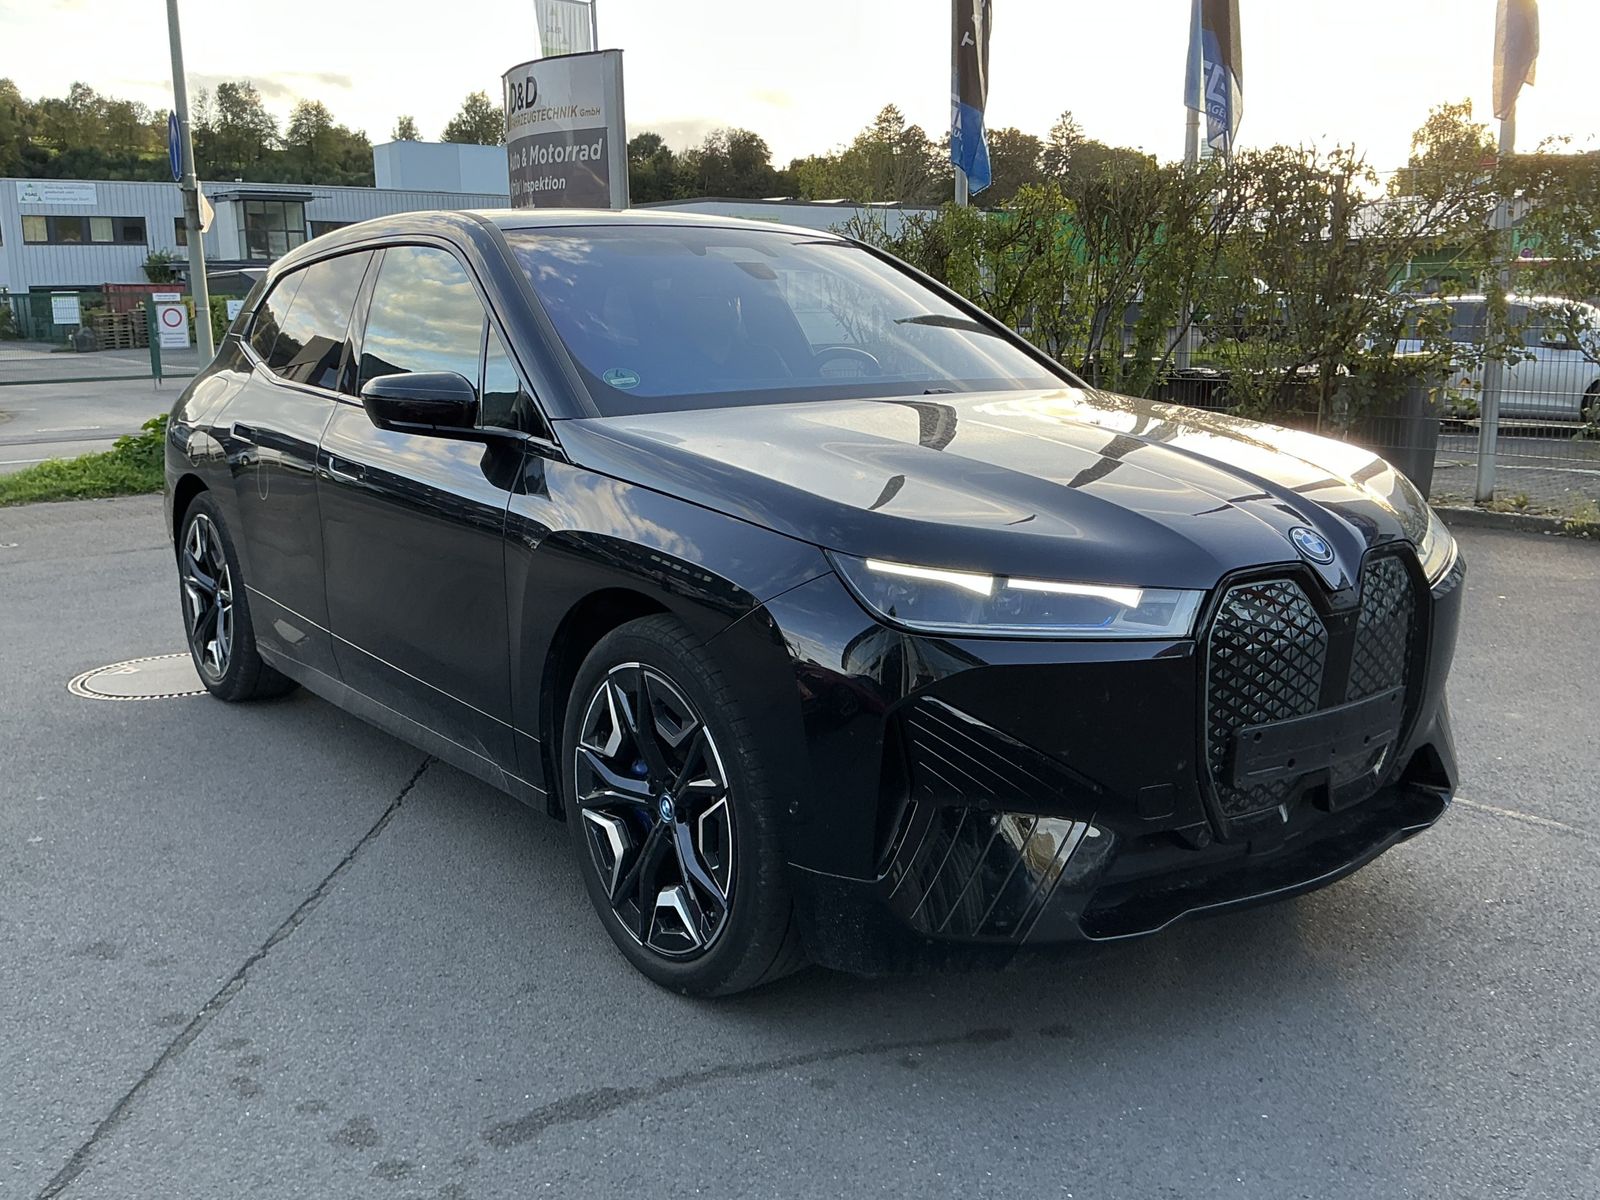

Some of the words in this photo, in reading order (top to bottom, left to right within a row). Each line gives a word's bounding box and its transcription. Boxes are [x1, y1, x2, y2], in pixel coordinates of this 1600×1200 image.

[510, 76, 538, 115] D&D
[580, 107, 601, 117] GmbH
[522, 147, 527, 167] &
[530, 138, 603, 166] Motorrad
